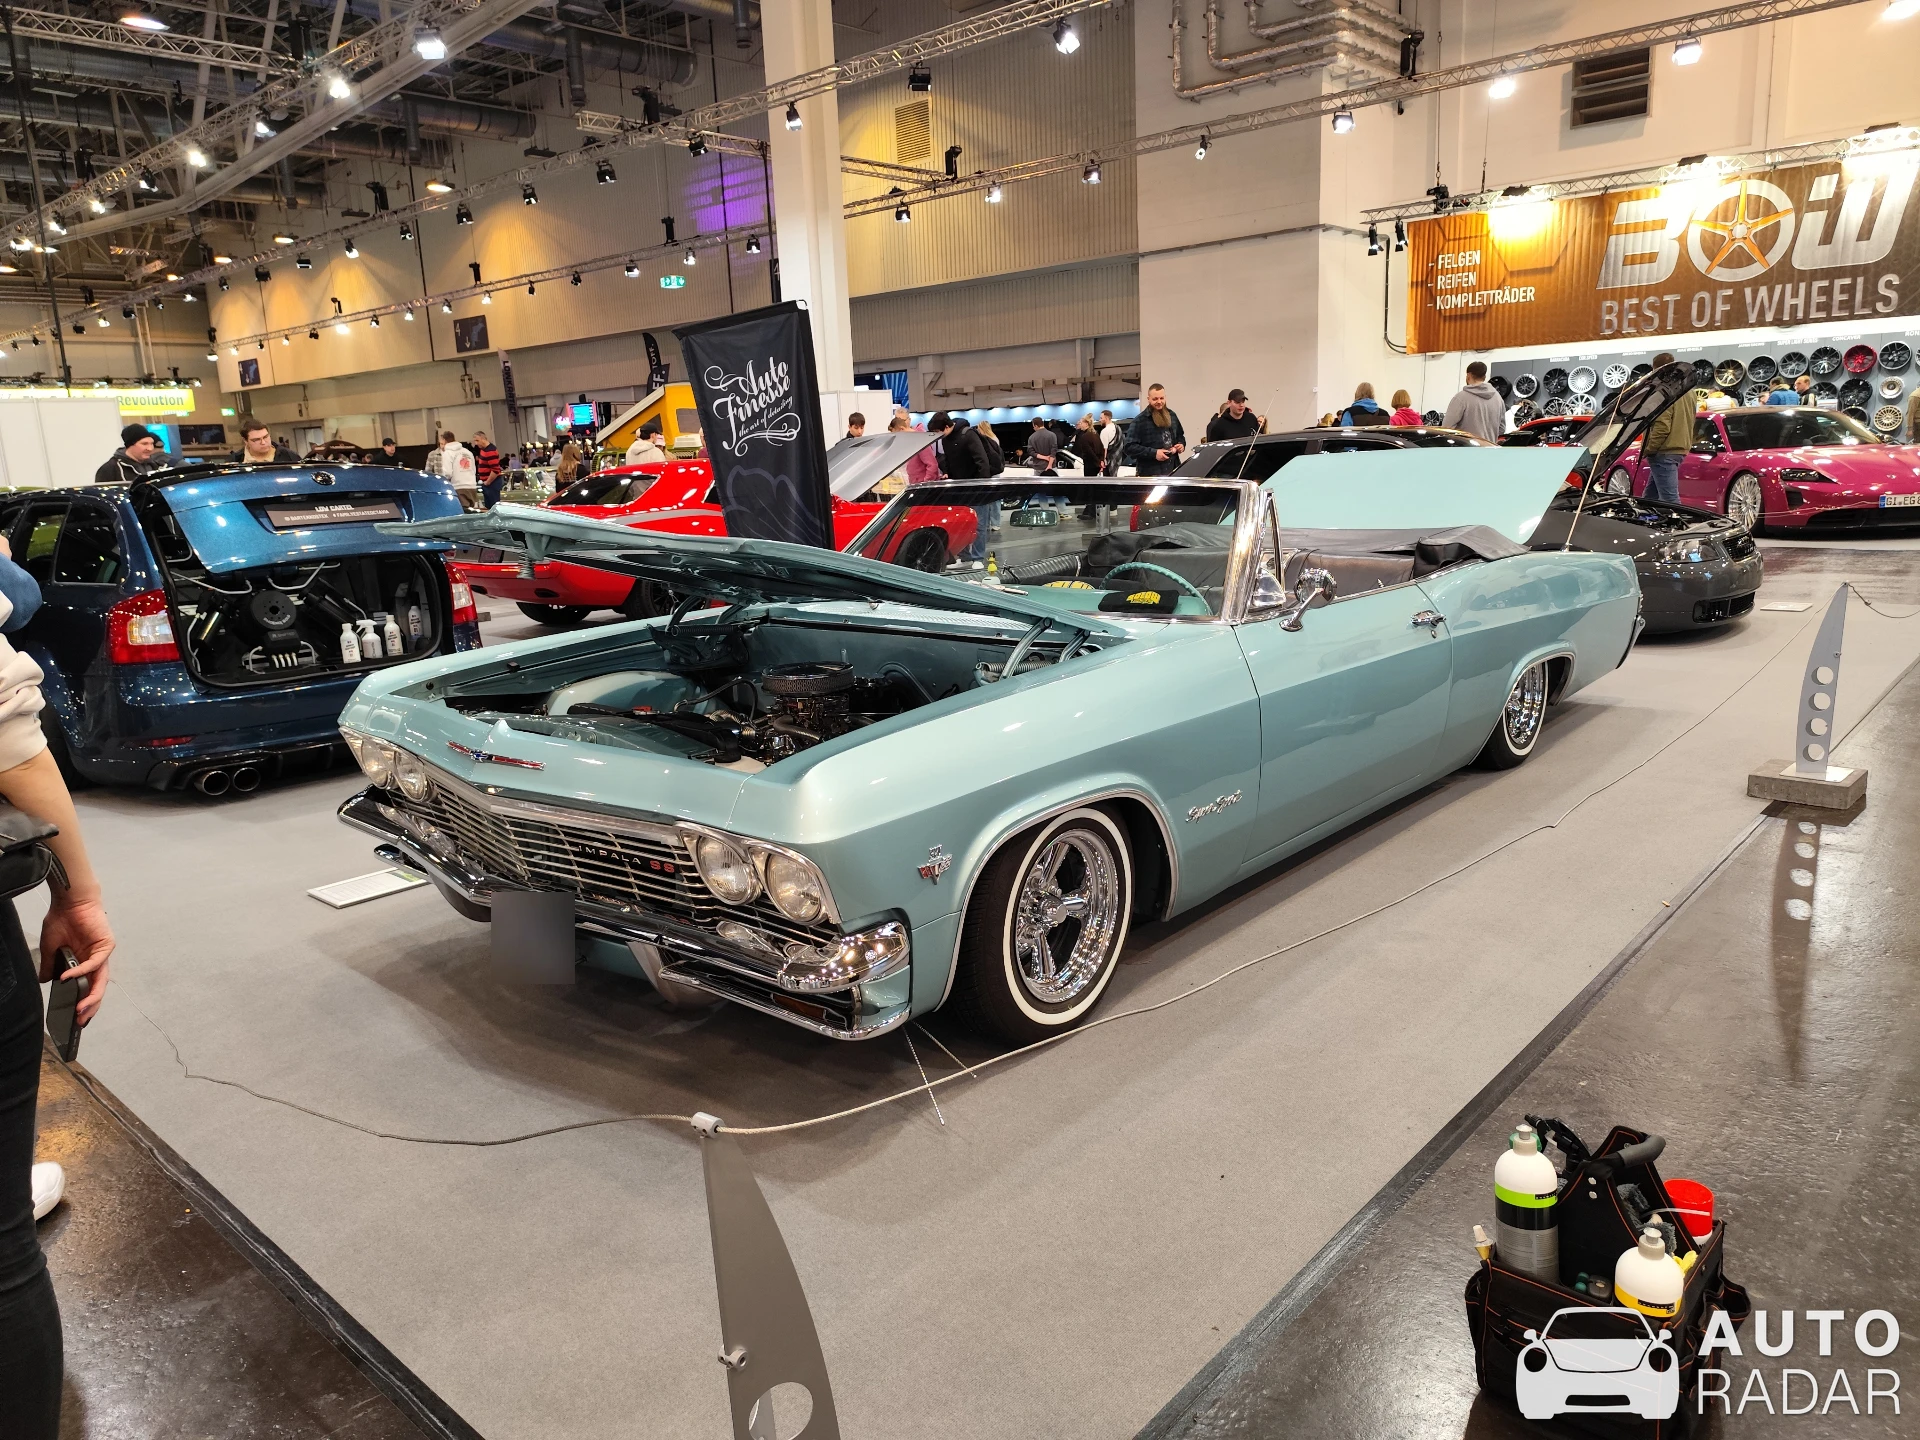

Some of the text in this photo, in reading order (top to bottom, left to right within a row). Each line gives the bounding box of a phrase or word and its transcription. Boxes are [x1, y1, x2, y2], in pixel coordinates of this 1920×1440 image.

[1437, 249, 1480, 270] FELGEN
[1436, 285, 1536, 311] KOMPLETTRÄDER
[1437, 271, 1477, 290] REIFEN
[1599, 273, 1900, 336] BEST OF WHEELS
[714, 356, 789, 405] Auto
[713, 375, 791, 450] Finesse
[739, 423, 749, 438] the
[750, 418, 760, 431] art
[767, 396, 793, 419] detailing
[578, 845, 675, 873] IMPALA SS
